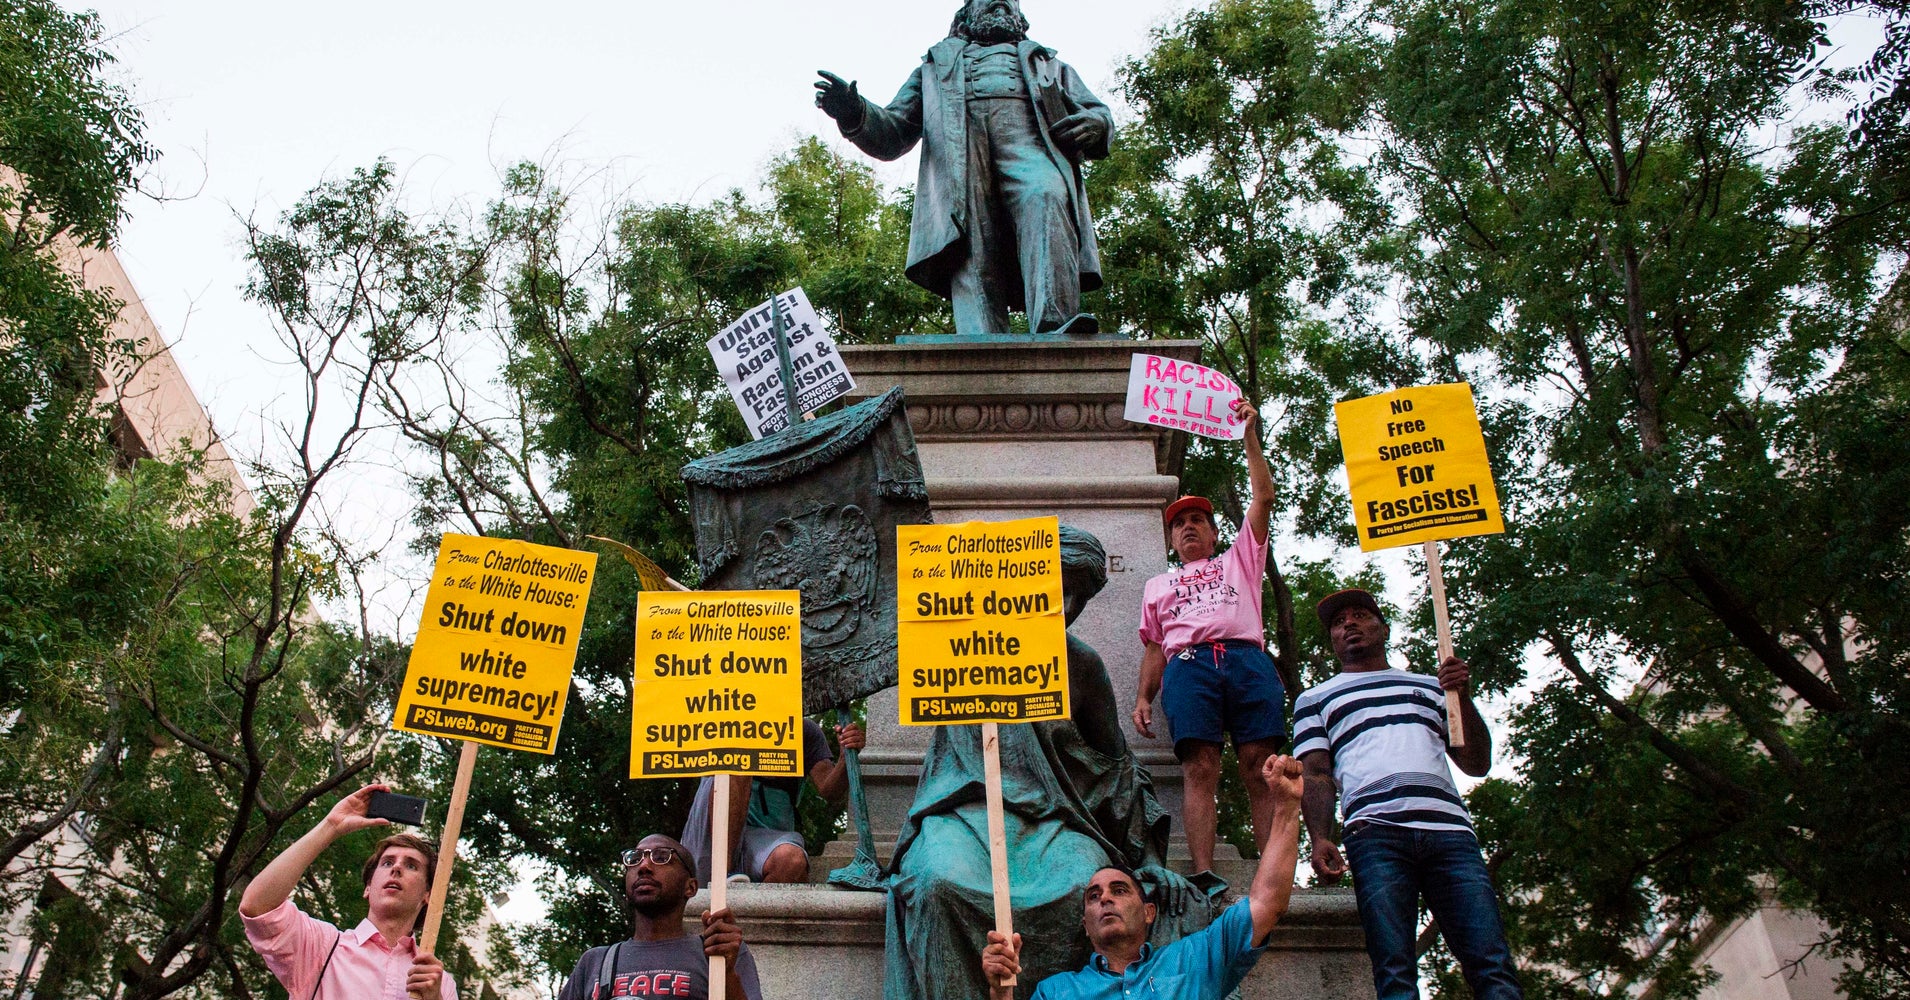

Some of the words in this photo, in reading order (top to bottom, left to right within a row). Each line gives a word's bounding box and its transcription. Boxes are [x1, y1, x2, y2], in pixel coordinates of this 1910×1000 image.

[718, 294, 799, 352] UNITE!
[741, 352, 814, 407] Racim
[815, 341, 832, 358] &
[1145, 356, 1242, 397] RACISM
[760, 407, 788, 433] PEOPL
[797, 375, 845, 405] CONGRESS
[1143, 384, 1244, 427] KILLS
[1389, 399, 1414, 415] No
[773, 420, 784, 432] OF
[1387, 419, 1426, 437] Free
[1378, 437, 1445, 461] Speech
[1396, 463, 1435, 488] For
[1366, 484, 1480, 523] Fascists!
[1377, 526, 1394, 536] Party
[1403, 518, 1434, 530] Socialism
[1434, 516, 1446, 524] and
[1446, 513, 1478, 523] Liberation
[909, 540, 942, 556] From
[947, 530, 1053, 554] Charlottesville
[448, 549, 481, 565] From
[484, 549, 588, 584] Charlottesville
[912, 567, 924, 579] to
[928, 564, 945, 578] the
[950, 559, 993, 579] White
[997, 559, 1050, 579] House:
[444, 575, 455, 587] to
[459, 575, 476, 590] the
[479, 574, 522, 600] White
[524, 581, 579, 609] House:
[917, 590, 974, 616] Shut
[983, 590, 1049, 616] down
[649, 605, 682, 618] From
[687, 601, 794, 618] Charlottesville
[439, 601, 495, 633] Shut
[501, 611, 566, 645] down
[651, 628, 662, 640] to
[667, 626, 684, 640] the
[689, 623, 732, 642] White
[737, 623, 791, 641] House:
[949, 630, 1020, 656] white
[460, 648, 527, 680] white
[654, 653, 712, 677] Shut
[720, 651, 788, 675] down
[912, 656, 1060, 693] supremacy!
[416, 675, 559, 720] supremacy!
[685, 688, 757, 714] white
[919, 698, 1018, 716] PSLweb.org
[1025, 696, 1042, 704] PARTY
[1025, 701, 1055, 710] SOCIALISM
[413, 708, 507, 740] PSLweb.org
[1025, 708, 1057, 717] LIBERATION
[512, 737, 543, 747] LIBERATION
[514, 730, 543, 741] SOCIALISM
[515, 724, 533, 733] PARTY
[533, 727, 544, 735] FOR
[646, 716, 795, 748] supremacy!
[651, 751, 751, 770] PSLweb.org
